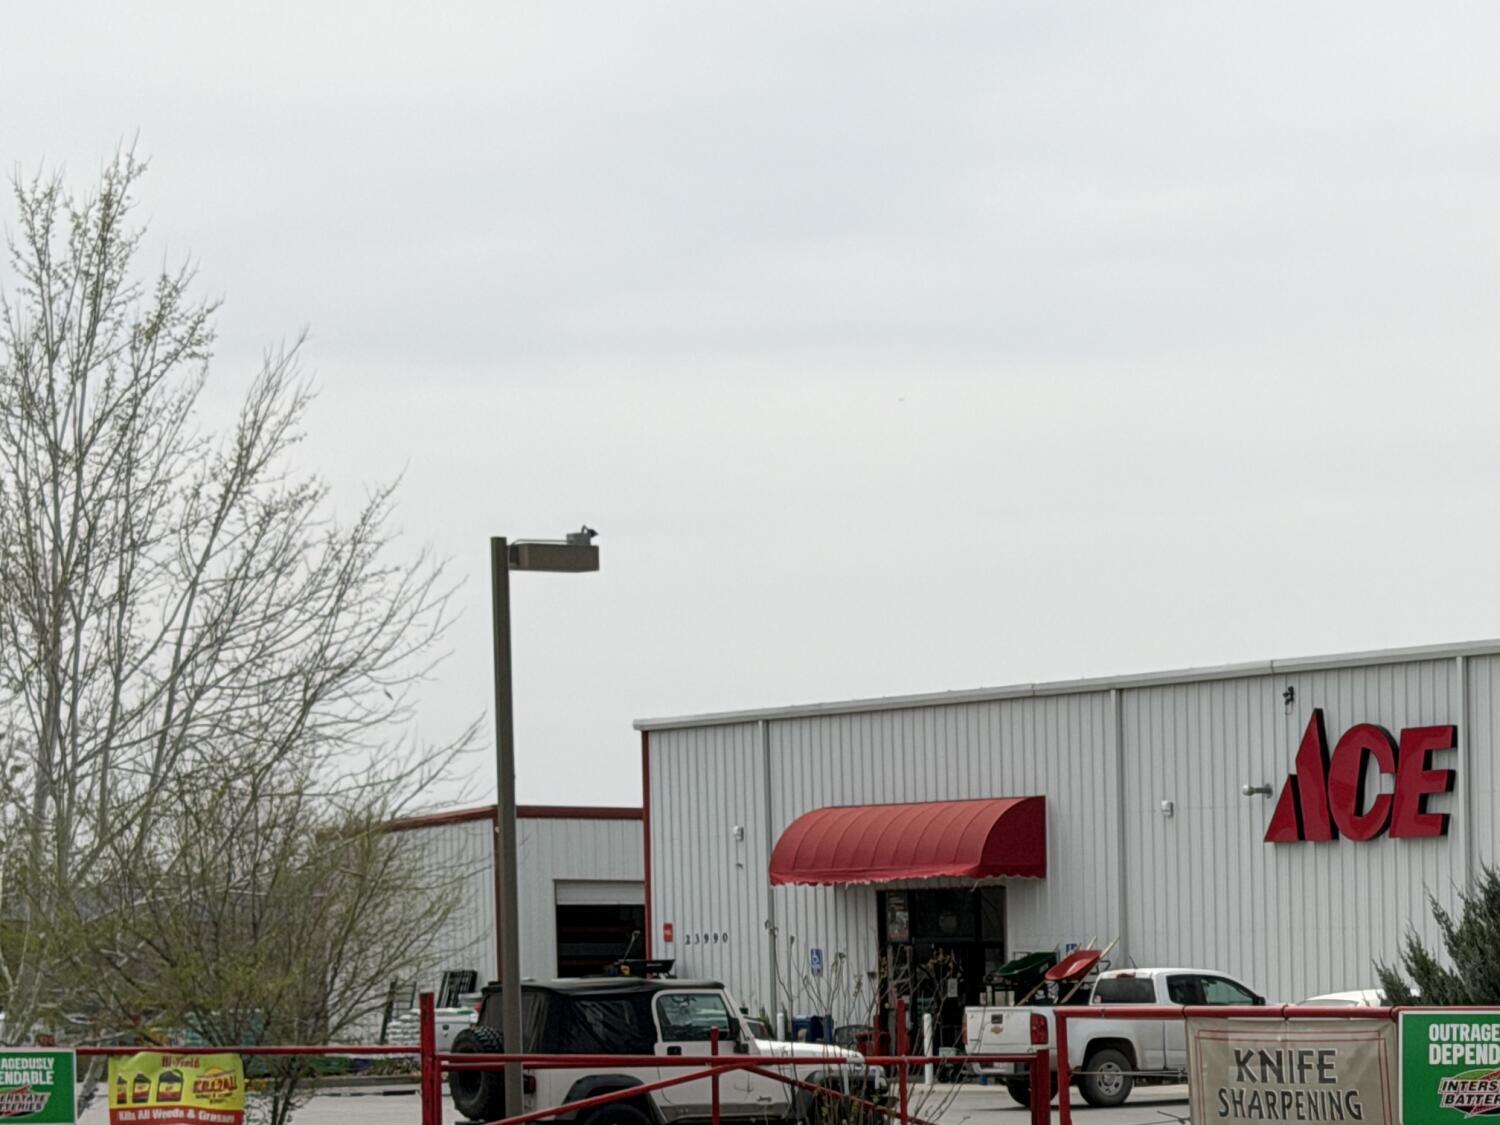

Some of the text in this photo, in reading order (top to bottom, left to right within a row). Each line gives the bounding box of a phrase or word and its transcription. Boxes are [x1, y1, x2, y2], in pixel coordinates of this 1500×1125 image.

[1264, 707, 1458, 842] ACE
[1233, 1048, 1338, 1084] KNIFE
[1218, 1087, 1364, 1121] SHARPENING
